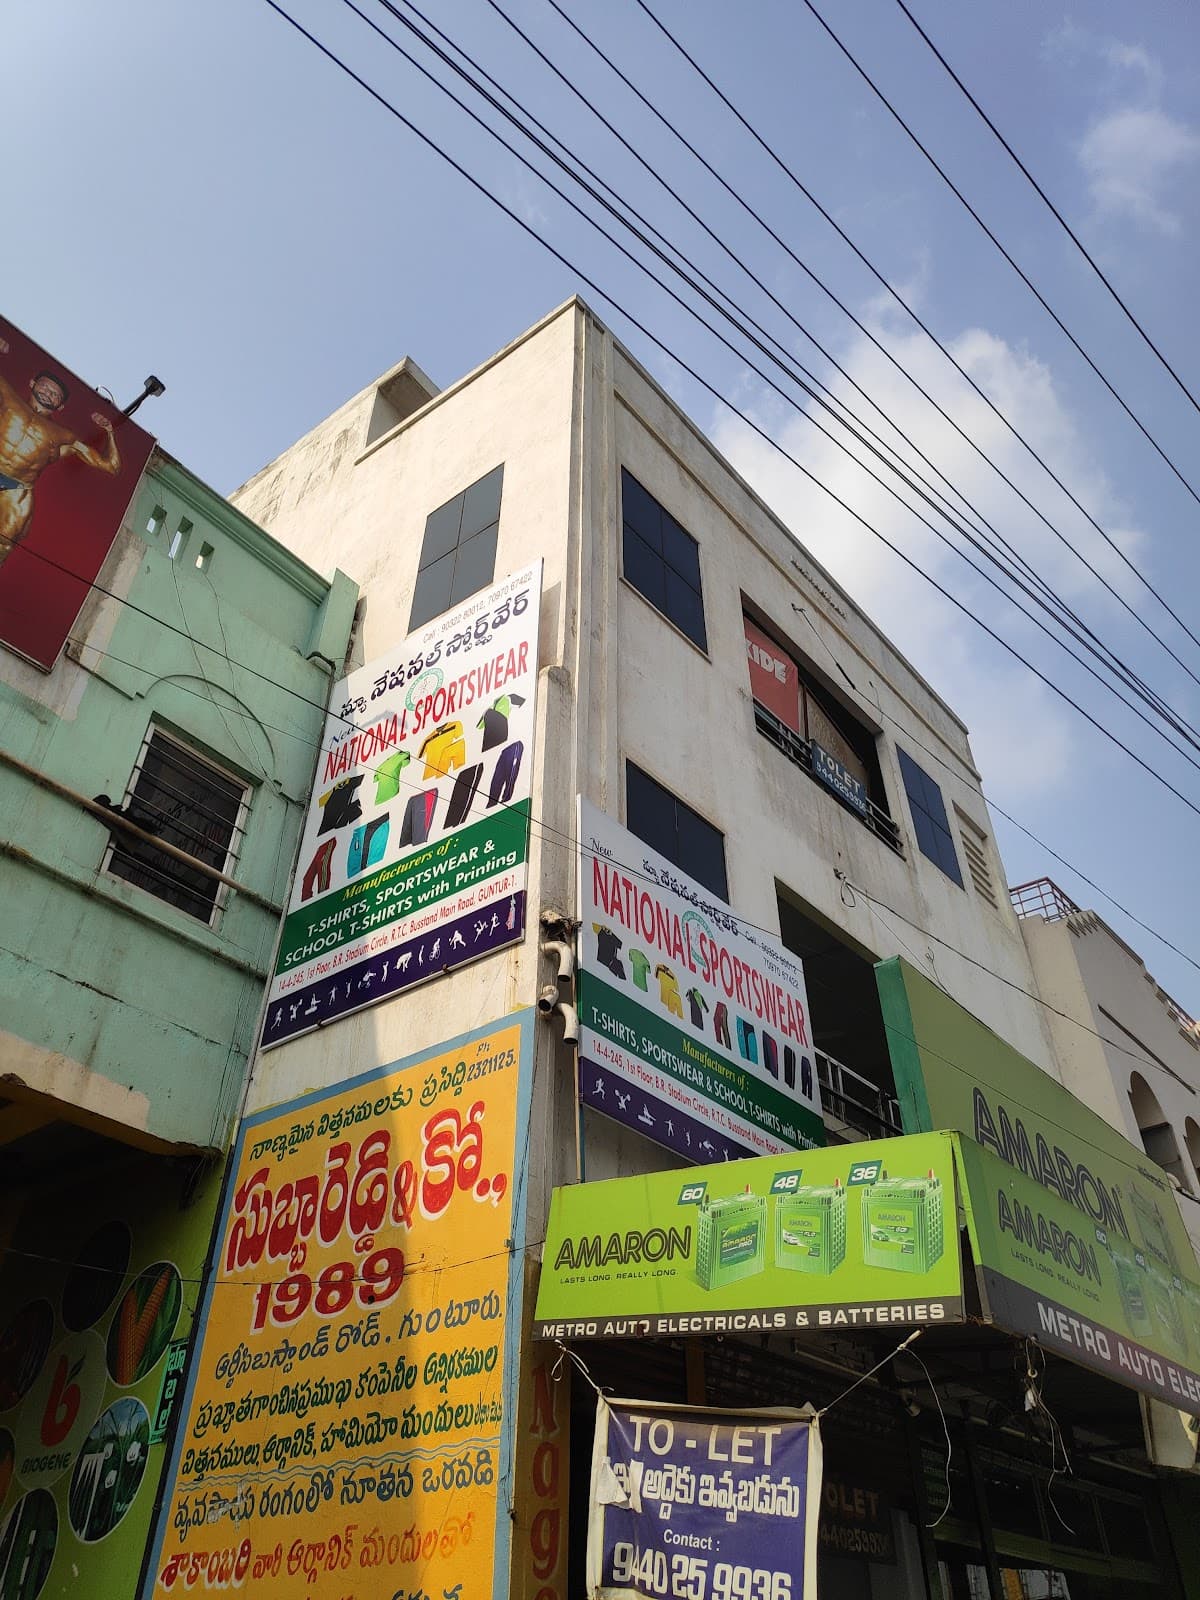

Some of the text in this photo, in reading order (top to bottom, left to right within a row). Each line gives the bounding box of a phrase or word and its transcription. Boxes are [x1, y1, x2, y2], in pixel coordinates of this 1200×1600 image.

[370, 640, 444, 700] నేషనల్
[323, 709, 407, 785] NATIONAL
[412, 641, 529, 735] SPORTSWEAR
[342, 850, 433, 901] Manufacturers
[437, 839, 451, 857] of
[590, 837, 613, 857] New
[284, 851, 517, 966] SCHOOL T-SHIRTS with Printing
[308, 840, 494, 937] T-SHIRTS, SPORTSWEAR &
[345, 943, 369, 962] Stadium
[391, 922, 407, 941] R.T.C.
[410, 910, 439, 933] Busstand
[440, 904, 455, 919] Main
[593, 856, 697, 974] NATIONAL
[700, 932, 808, 1048] SPORTSWEAR
[591, 1006, 640, 1052] T-SHIRTS,
[642, 1037, 705, 1088] SPORTSWEAR
[706, 1077, 713, 1093] &
[713, 1081, 749, 1114] SCHOOL
[749, 1100, 781, 1132] T-SHIRTS
[781, 1122, 797, 1141] with
[592, 1039, 625, 1071] 14-4-245,
[626, 1058, 636, 1075] 1st
[637, 1065, 654, 1088] Floor,
[655, 1075, 667, 1093] B.R.
[668, 1083, 691, 1106] Stadium
[692, 1097, 711, 1120] Circle,
[711, 1108, 726, 1128] R.T.C.
[682, 1038, 736, 1084] Manufacturers
[737, 1075, 745, 1091] of
[250, 1120, 314, 1161] నాణ్యమైన
[225, 1129, 391, 1274] సుబ్బారెడ్డి
[392, 1160, 419, 1231] &
[681, 1186, 704, 1200] 60
[774, 1175, 799, 1190] 48
[851, 1165, 878, 1181] 36
[553, 1225, 692, 1271] AMARON
[998, 1189, 1102, 1287] AMARON
[252, 1248, 404, 1333] 1989
[560, 1276, 586, 1285] LASTS
[616, 1271, 648, 1280] REALLY
[542, 1323, 597, 1337] METRO
[657, 1311, 786, 1332] ELECTRICALS
[796, 1311, 810, 1326] &
[818, 1303, 945, 1326] BATTERIES
[1037, 1302, 1112, 1361] METRO
[1118, 1342, 1165, 1386] AUTO
[400, 1400, 473, 1438] మందులు
[629, 1415, 675, 1456] TO
[708, 1424, 782, 1466] LET
[21, 1452, 72, 1474] BIOGENE
[259, 1470, 334, 1517] రంగంలో
[340, 1462, 413, 1505] నూతన
[422, 1450, 494, 1492] ఒరవడి
[642, 1463, 696, 1520] అద్దెకు
[699, 1470, 800, 1523] ఇవ్వబడును
[825, 1482, 880, 1520] OLET
[252, 1542, 282, 1579] వారి
[287, 1524, 358, 1584] ఆర్గానిక్
[360, 1511, 475, 1568] మందులతో
[663, 1529, 713, 1550] Contact
[612, 1541, 792, 1600] 9440 25 9936
